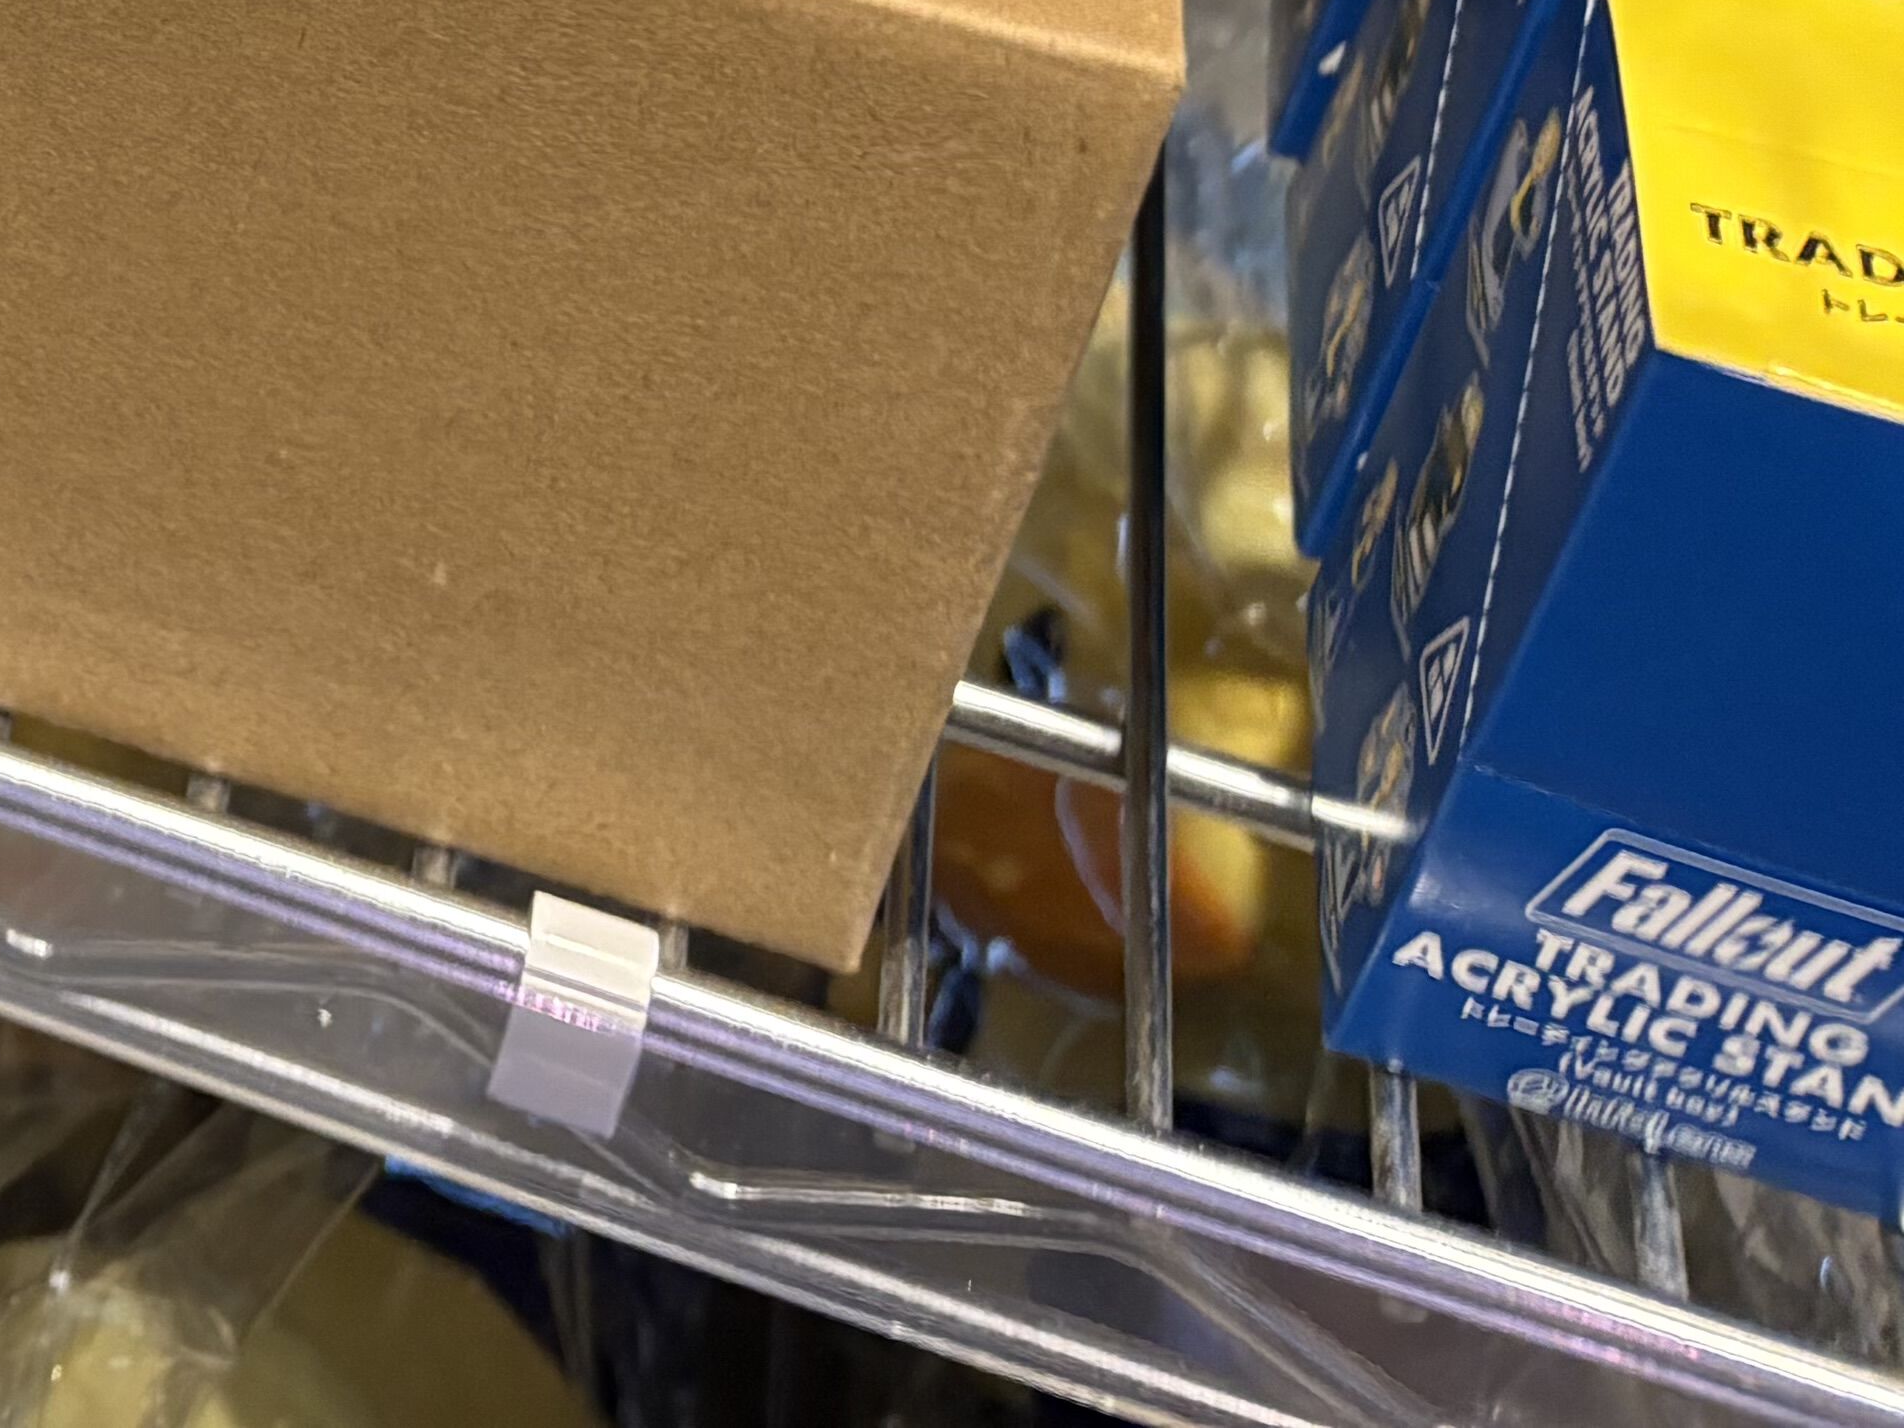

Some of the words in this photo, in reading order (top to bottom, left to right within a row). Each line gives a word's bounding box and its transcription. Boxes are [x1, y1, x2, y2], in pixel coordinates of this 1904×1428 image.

[1392, 931, 1699, 1058] ACRYLIC
[1562, 850, 1902, 1002] Fallout
[1537, 928, 1869, 1066] TRADING
